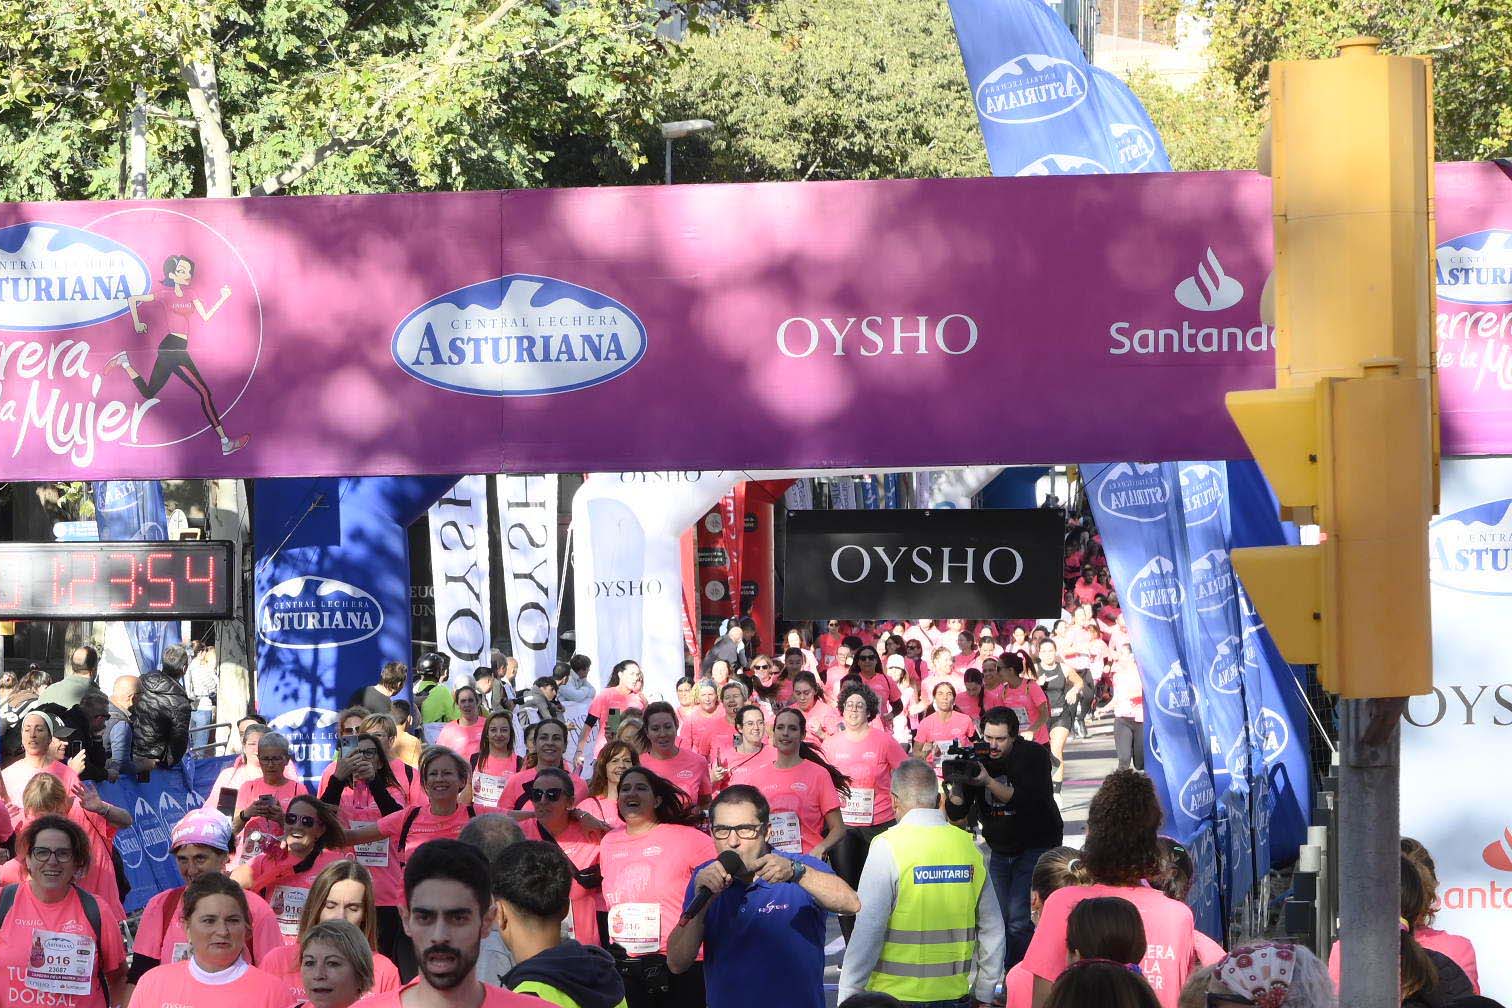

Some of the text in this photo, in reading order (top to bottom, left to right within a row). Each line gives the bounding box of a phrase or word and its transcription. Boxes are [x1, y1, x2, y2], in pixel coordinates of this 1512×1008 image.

[451, 314, 619, 330] CENTRAL LECHERA
[411, 321, 627, 366] ASTURIANA
[776, 313, 978, 358] OYSHO
[13, 375, 160, 467] Mujer
[829, 544, 1025, 585] OYSHO
[274, 600, 370, 610] CENTRAL LECHERA
[262, 609, 375, 632] ASTURIANA
[915, 867, 970, 881] VOLUNTARIS
[46, 955, 71, 965] 016
[8, 987, 76, 1007] DORSAL
